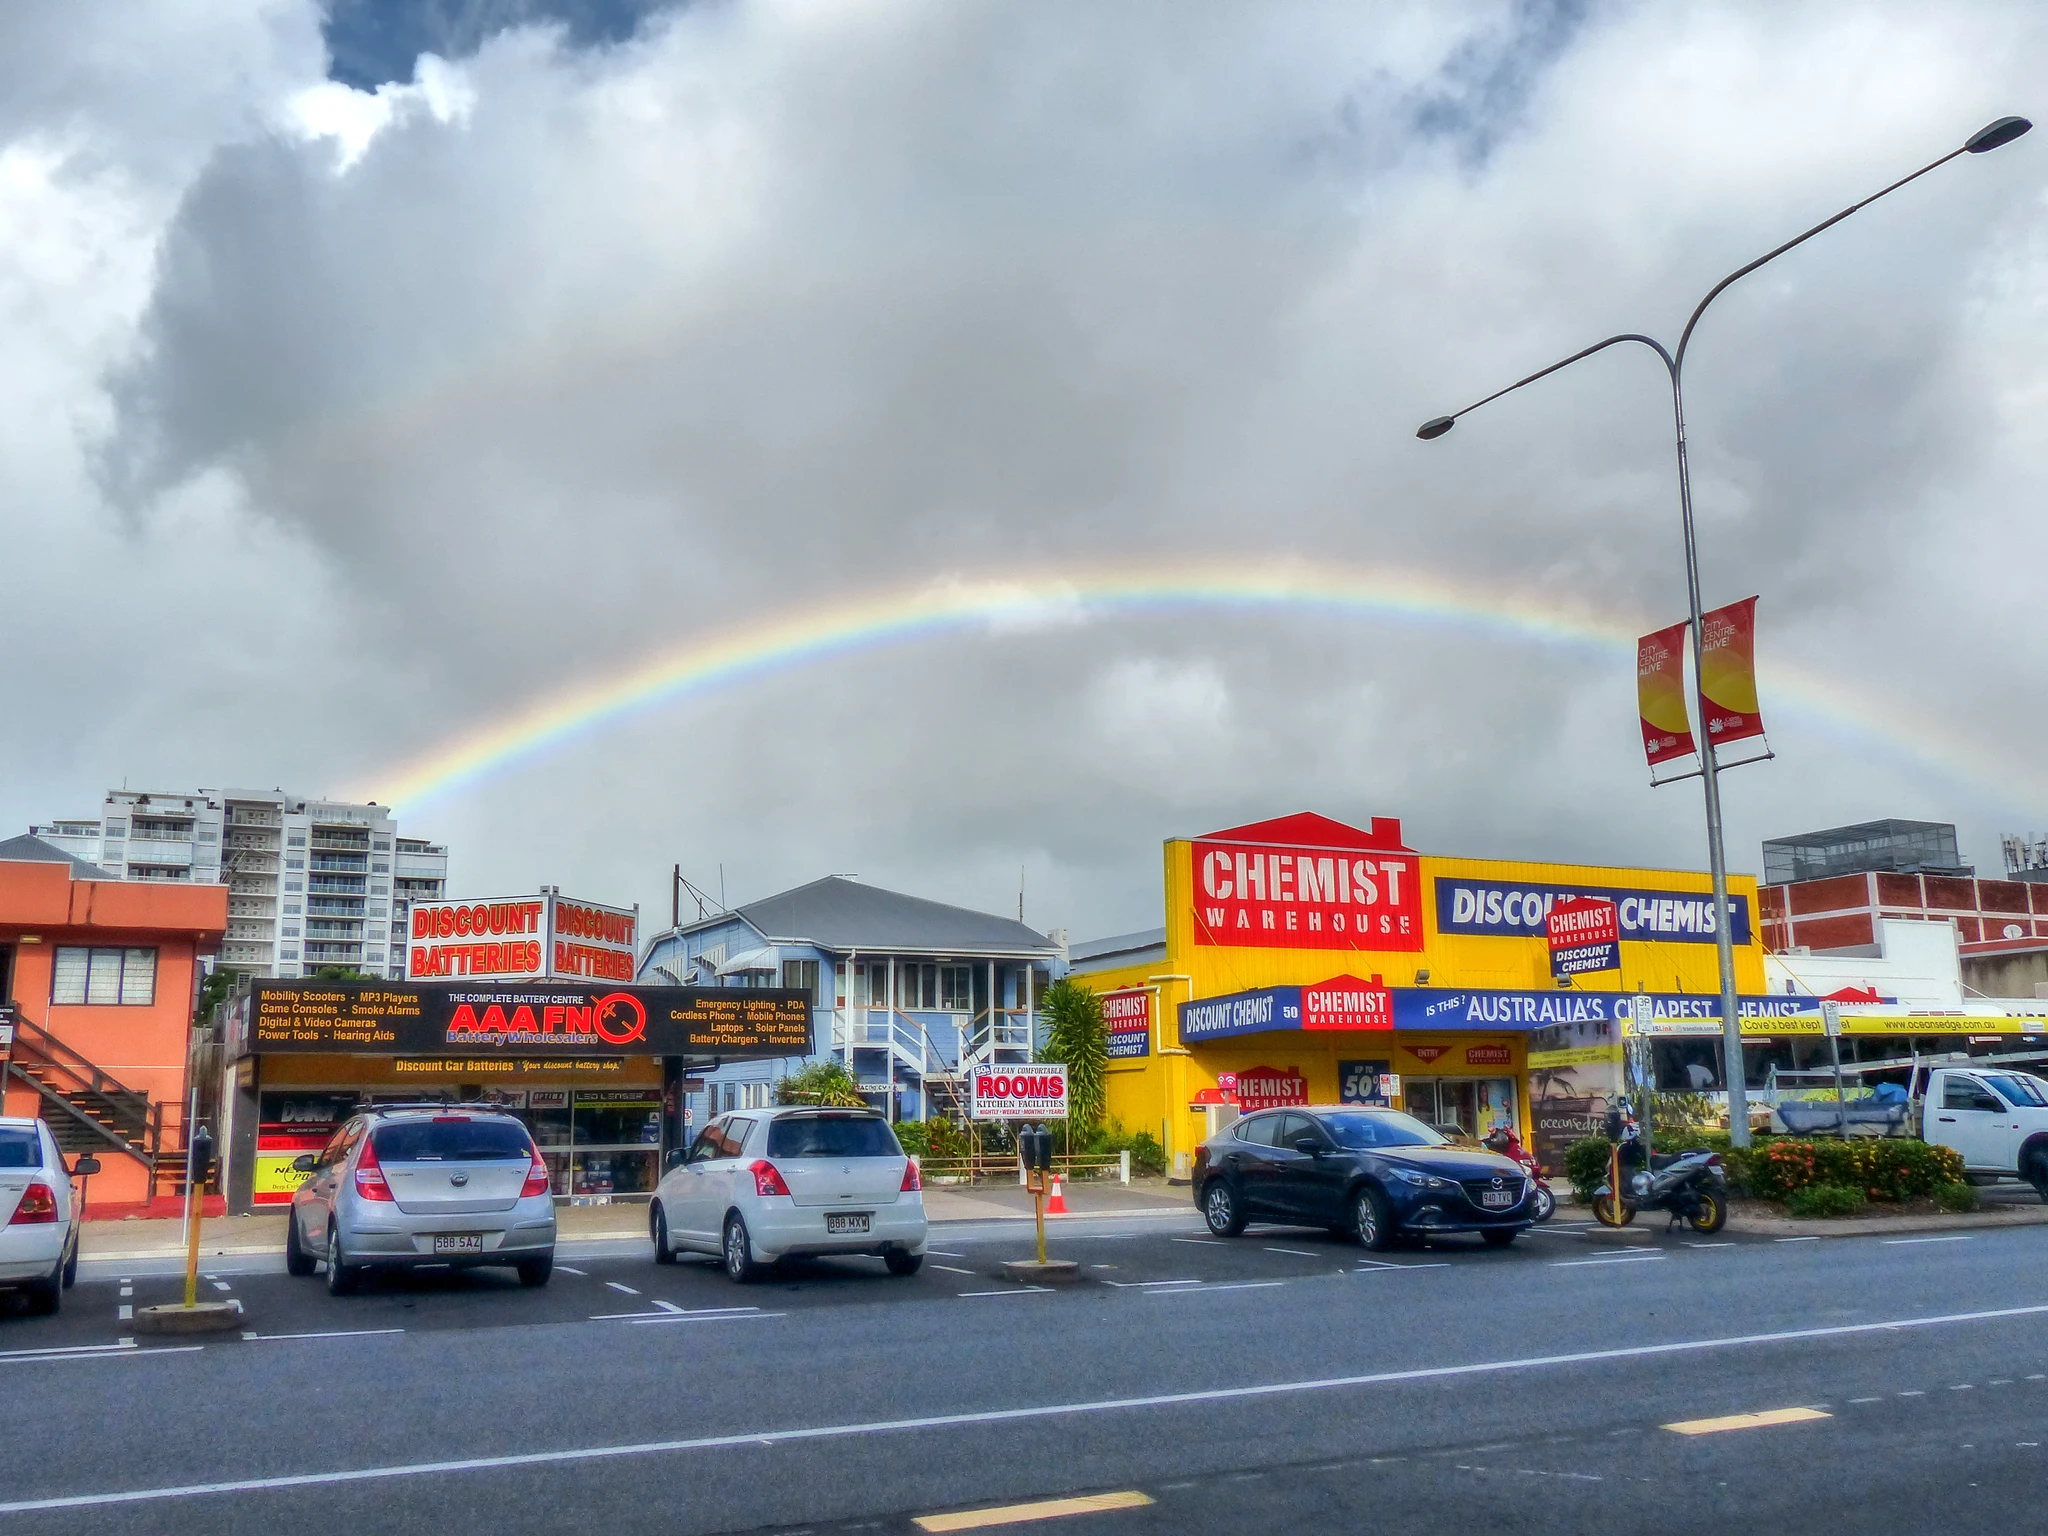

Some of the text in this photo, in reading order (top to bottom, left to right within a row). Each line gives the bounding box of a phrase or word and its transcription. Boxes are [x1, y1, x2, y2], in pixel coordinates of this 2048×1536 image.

[1704, 620, 1723, 633] CITY
[1704, 625, 1736, 643] CENTRE
[1640, 643, 1658, 658] CITY
[1703, 636, 1730, 652] ALIVE!
[1640, 649, 1669, 667] CENTRE
[1203, 850, 1406, 905] CHEMIST
[1452, 888, 1610, 927] DISCO
[412, 901, 543, 939] DISCOUNT
[555, 901, 635, 945] DISCOUNT
[1206, 907, 1410, 934] WAREHOUSE
[1550, 907, 1612, 933] CHEMIST
[1552, 929, 1614, 945] WAREHOUSE
[410, 940, 541, 977] BATTERIES
[1556, 944, 1612, 962] DISCOUNT
[554, 940, 634, 982] BATTERIES
[1562, 957, 1608, 972] CHEMIST
[261, 991, 300, 1003] Mobility
[302, 991, 346, 1002] Scooters
[360, 993, 381, 1002] MP3
[383, 993, 418, 1004] Players
[449, 994, 584, 1004] THE COMPLETE BATTERY CENTRE
[1307, 991, 1387, 1013] CHEMIST
[1639, 998, 1650, 1006] 3P
[260, 1004, 289, 1014] Game
[292, 1004, 338, 1014] Consoles
[352, 1005, 385, 1015] Smoke
[387, 1006, 421, 1015] Alarms
[695, 1000, 742, 1010] Emergency
[743, 1000, 776, 1010] Lighting
[787, 1001, 805, 1009] PDA
[1103, 996, 1147, 1018] CHEMIST
[1426, 1006, 1435, 1017] IS
[1439, 999, 1460, 1012] THIS
[1466, 995, 1604, 1022] AUSTRALIA'S
[1614, 998, 1713, 1019] CHAPEST
[1738, 1001, 1801, 1018] HEMIST
[1826, 1002, 1836, 1011] 3P
[670, 1010, 707, 1020] Cordless
[709, 1011, 735, 1020] Phone
[747, 1012, 773, 1021] Mobile
[775, 1012, 805, 1021] Phones
[1186, 995, 1274, 1034] DISCOUNT CHEMIST
[1283, 1006, 1298, 1019] 50
[1309, 1014, 1388, 1024] WAREHOUSE
[259, 1017, 377, 1028] Digital & Video Cameras
[711, 1023, 744, 1033] Laptops
[755, 1024, 777, 1032] Solar
[778, 1024, 805, 1033] Panels
[1107, 1017, 1147, 1028] AREHOUSE
[1744, 1020, 1777, 1030] Cove's
[1779, 1020, 1798, 1030] best
[1800, 1020, 1820, 1032] kept
[1884, 1020, 1996, 1031] www.oceansedge.com.au
[258, 1030, 290, 1040] Power
[292, 1030, 319, 1040] Tools
[333, 1031, 371, 1042] Hearing
[373, 1031, 395, 1041] Aids
[446, 1030, 599, 1046] Battery Wholesalers
[690, 1034, 720, 1044] Battery
[721, 1035, 759, 1045] Chargers
[769, 1035, 806, 1044] Inverters
[1108, 1044, 1143, 1056] CHEMIST
[1418, 1048, 1440, 1058] ENTRY
[1468, 1049, 1508, 1058] CHEMIST
[396, 1060, 443, 1071] Discount
[445, 1061, 464, 1071] Car
[466, 1060, 514, 1071] Batteries
[543, 1061, 572, 1069] discount
[575, 1061, 600, 1071] battery
[1017, 1067, 1063, 1075] COMFORTABLE
[976, 1075, 1064, 1099] ROOMS
[1237, 1079, 1302, 1097] HEMIST
[534, 1092, 565, 1100] OPTIMA
[600, 1092, 644, 1100] LENSER
[976, 1100, 1064, 1108] KITCHEN FACILITIES
[1540, 1115, 1606, 1138] oceansedge
[849, 1218, 868, 1228] MXW
[437, 1237, 480, 1248] 588 SAZ
